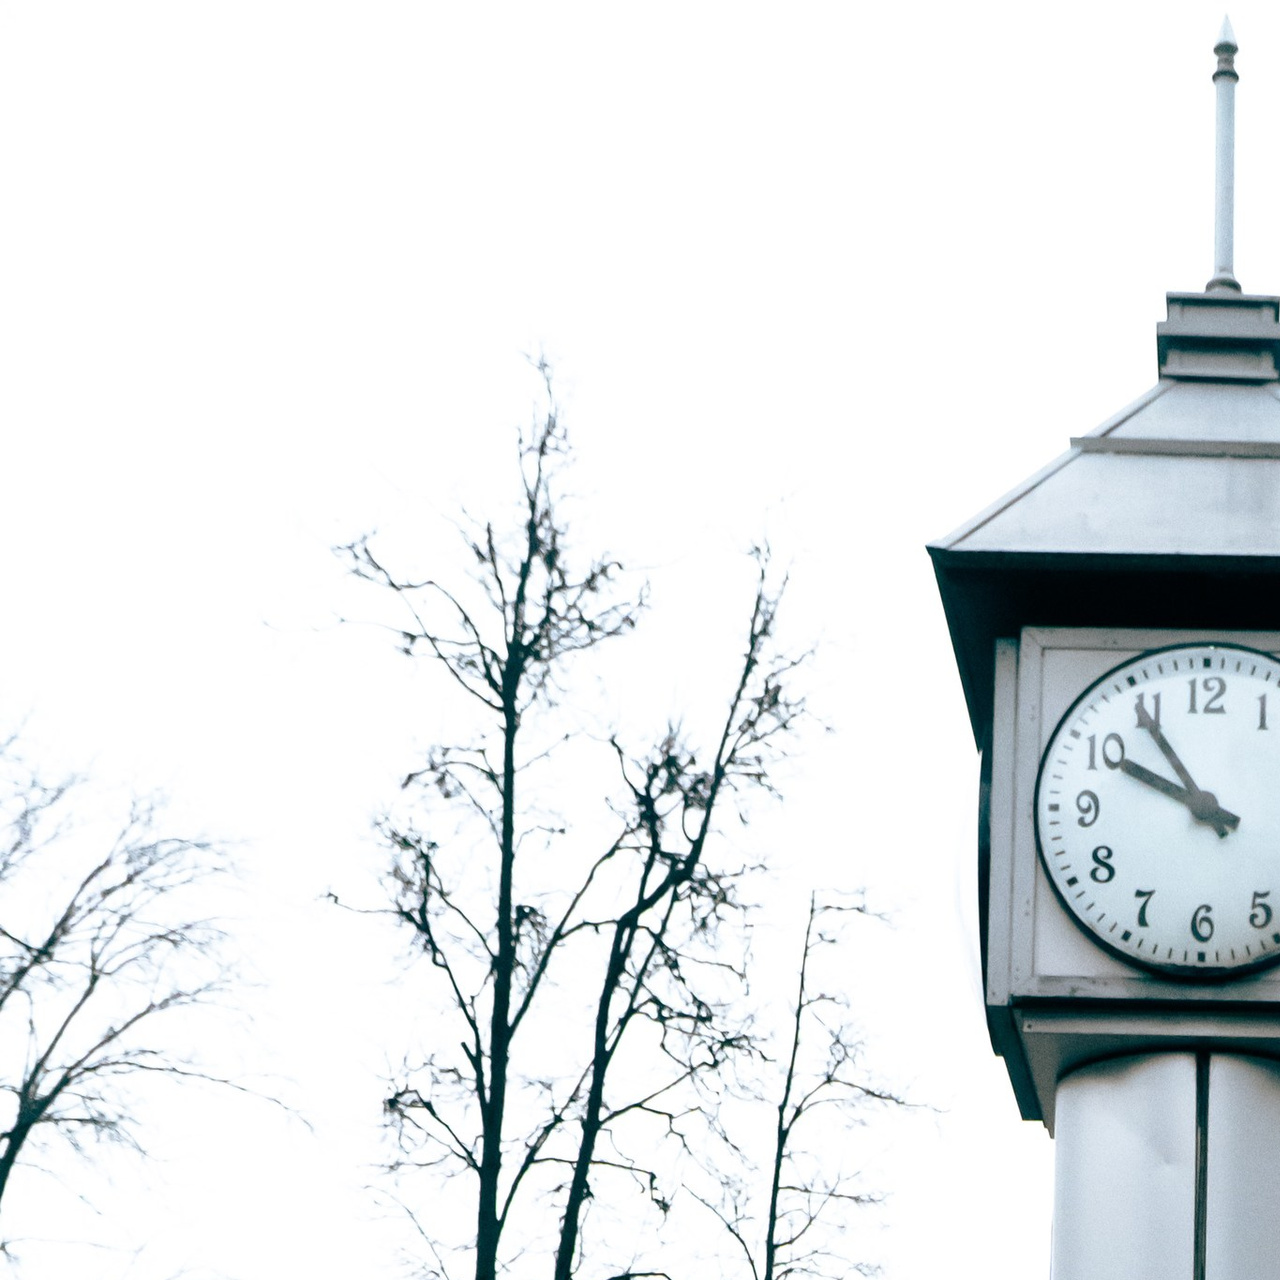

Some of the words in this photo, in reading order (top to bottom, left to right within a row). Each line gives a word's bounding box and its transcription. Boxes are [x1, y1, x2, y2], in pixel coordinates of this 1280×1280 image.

[1187, 676, 1227, 714] 12
[1257, 694, 1269, 730] 1
[1087, 733, 1126, 771] 10
[1075, 790, 1100, 828] 9
[1089, 845, 1116, 884] 8
[1134, 889, 1156, 927] 7
[1190, 904, 1214, 943] 6
[1249, 891, 1272, 929] 5
